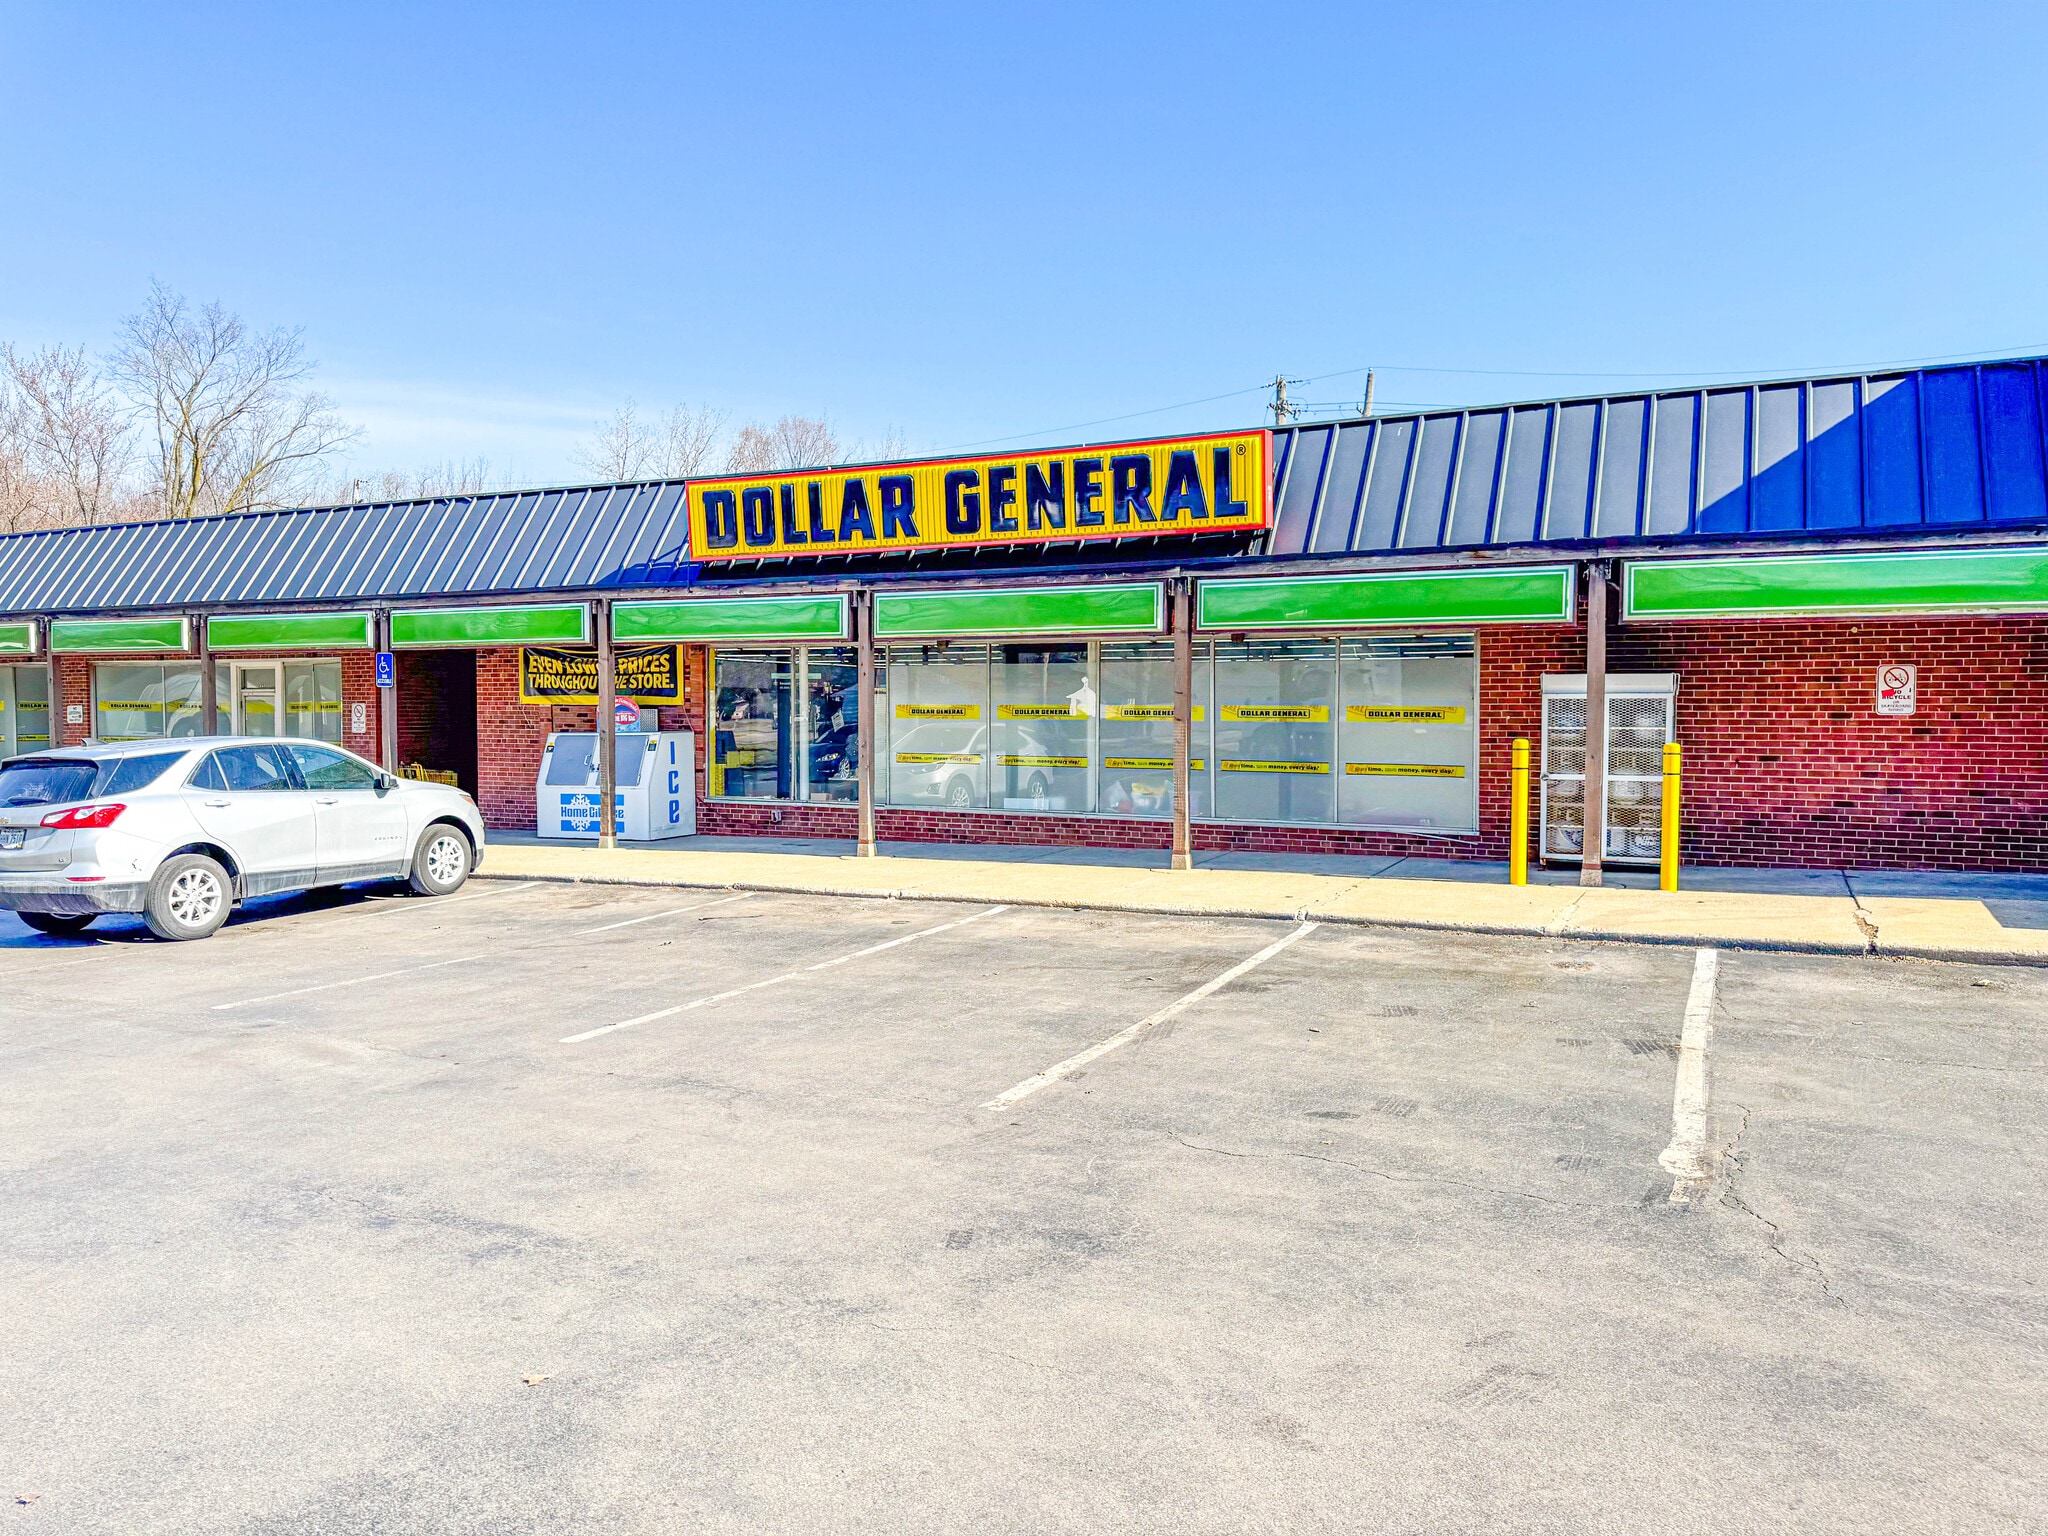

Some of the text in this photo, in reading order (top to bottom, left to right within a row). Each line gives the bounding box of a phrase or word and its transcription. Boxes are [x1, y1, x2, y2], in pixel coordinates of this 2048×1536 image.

[702, 446, 1248, 549] DOLLAR GENERAL
[528, 654, 670, 675] EVEN LOW PRICES
[528, 673, 675, 690] THROUGHOU HE STORE.
[561, 806, 588, 817] Home
